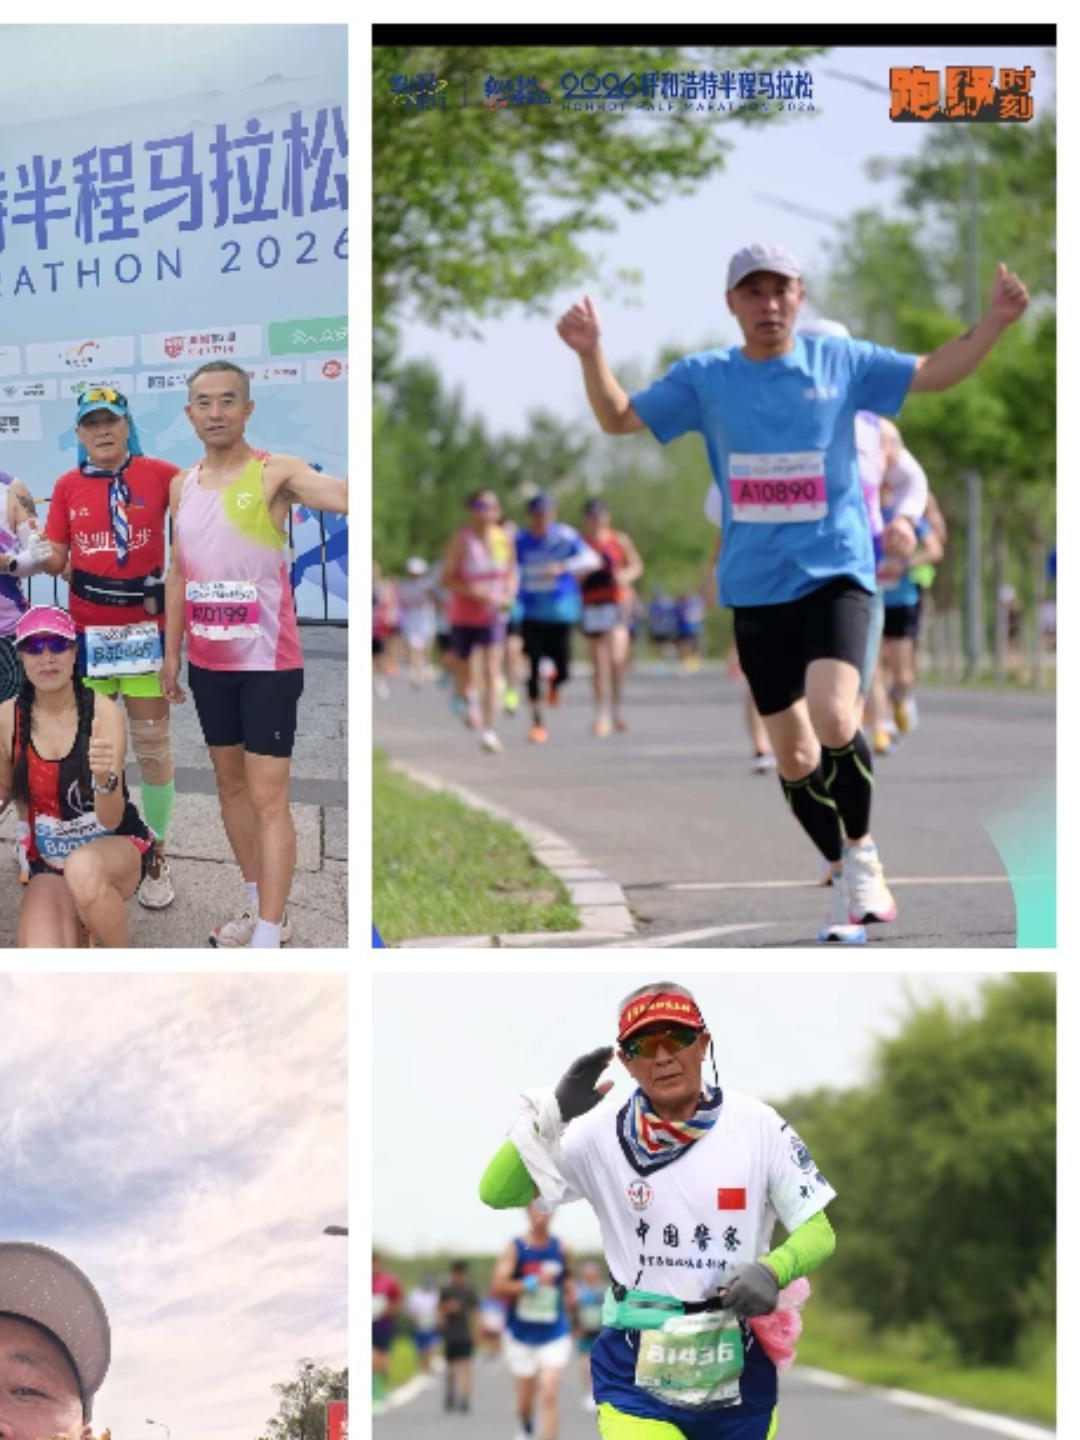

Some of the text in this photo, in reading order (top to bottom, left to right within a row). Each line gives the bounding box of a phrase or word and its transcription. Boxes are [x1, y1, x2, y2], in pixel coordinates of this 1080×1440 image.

[740, 481, 817, 503] A10890
[635, 1219, 742, 1251] 中国警察
